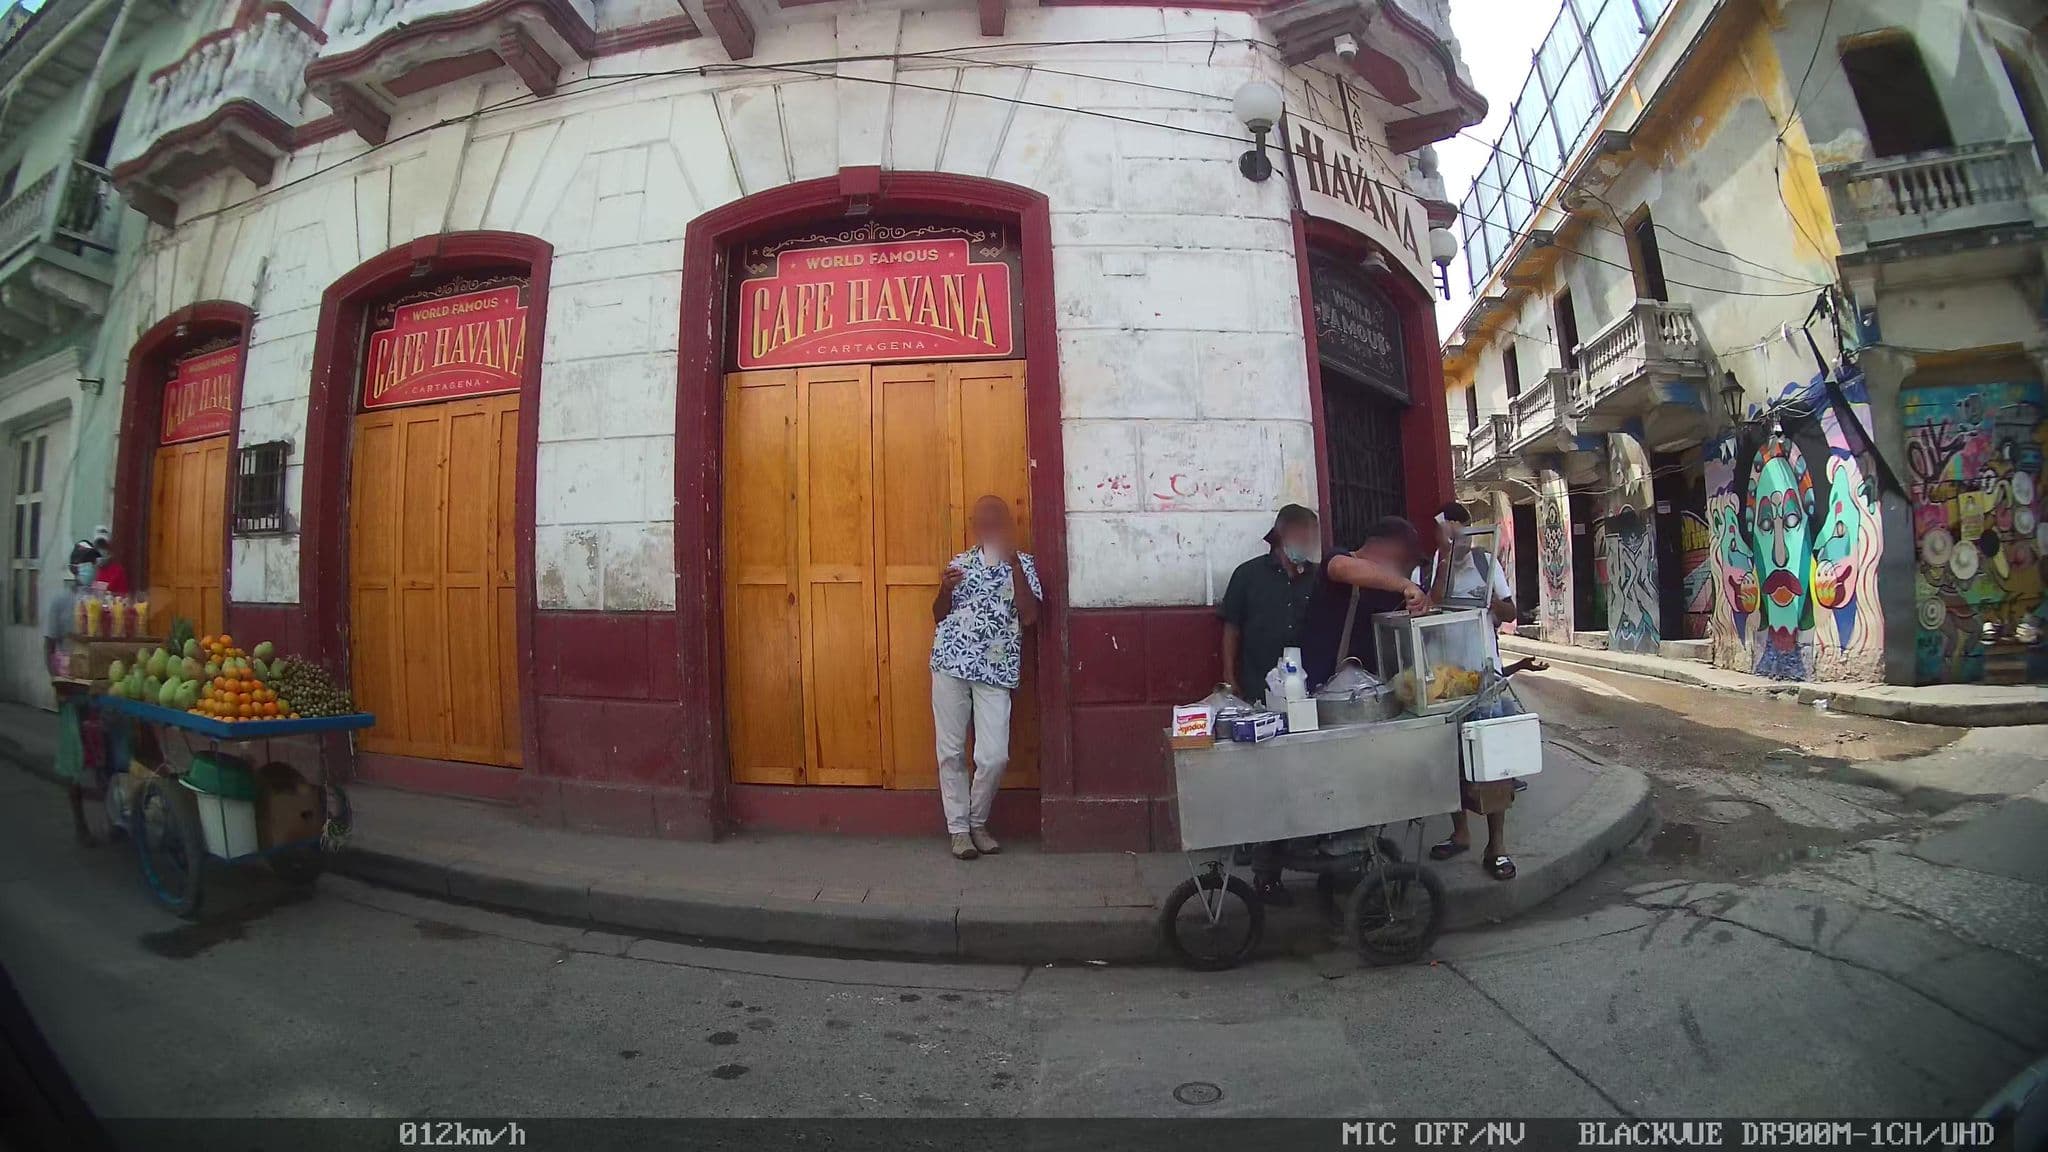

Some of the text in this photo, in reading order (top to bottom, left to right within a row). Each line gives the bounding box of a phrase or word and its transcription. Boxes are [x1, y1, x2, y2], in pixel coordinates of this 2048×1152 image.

[1296, 124, 1423, 266] HAVANA
[806, 249, 939, 270] WORLD FAMOUS
[412, 297, 499, 321] WORLD FAMOUS
[752, 272, 997, 359] CAFE HAVANA
[817, 341, 925, 354] CARTAGENA
[373, 331, 428, 399] CAFE
[411, 378, 481, 394] CARTAGENA
